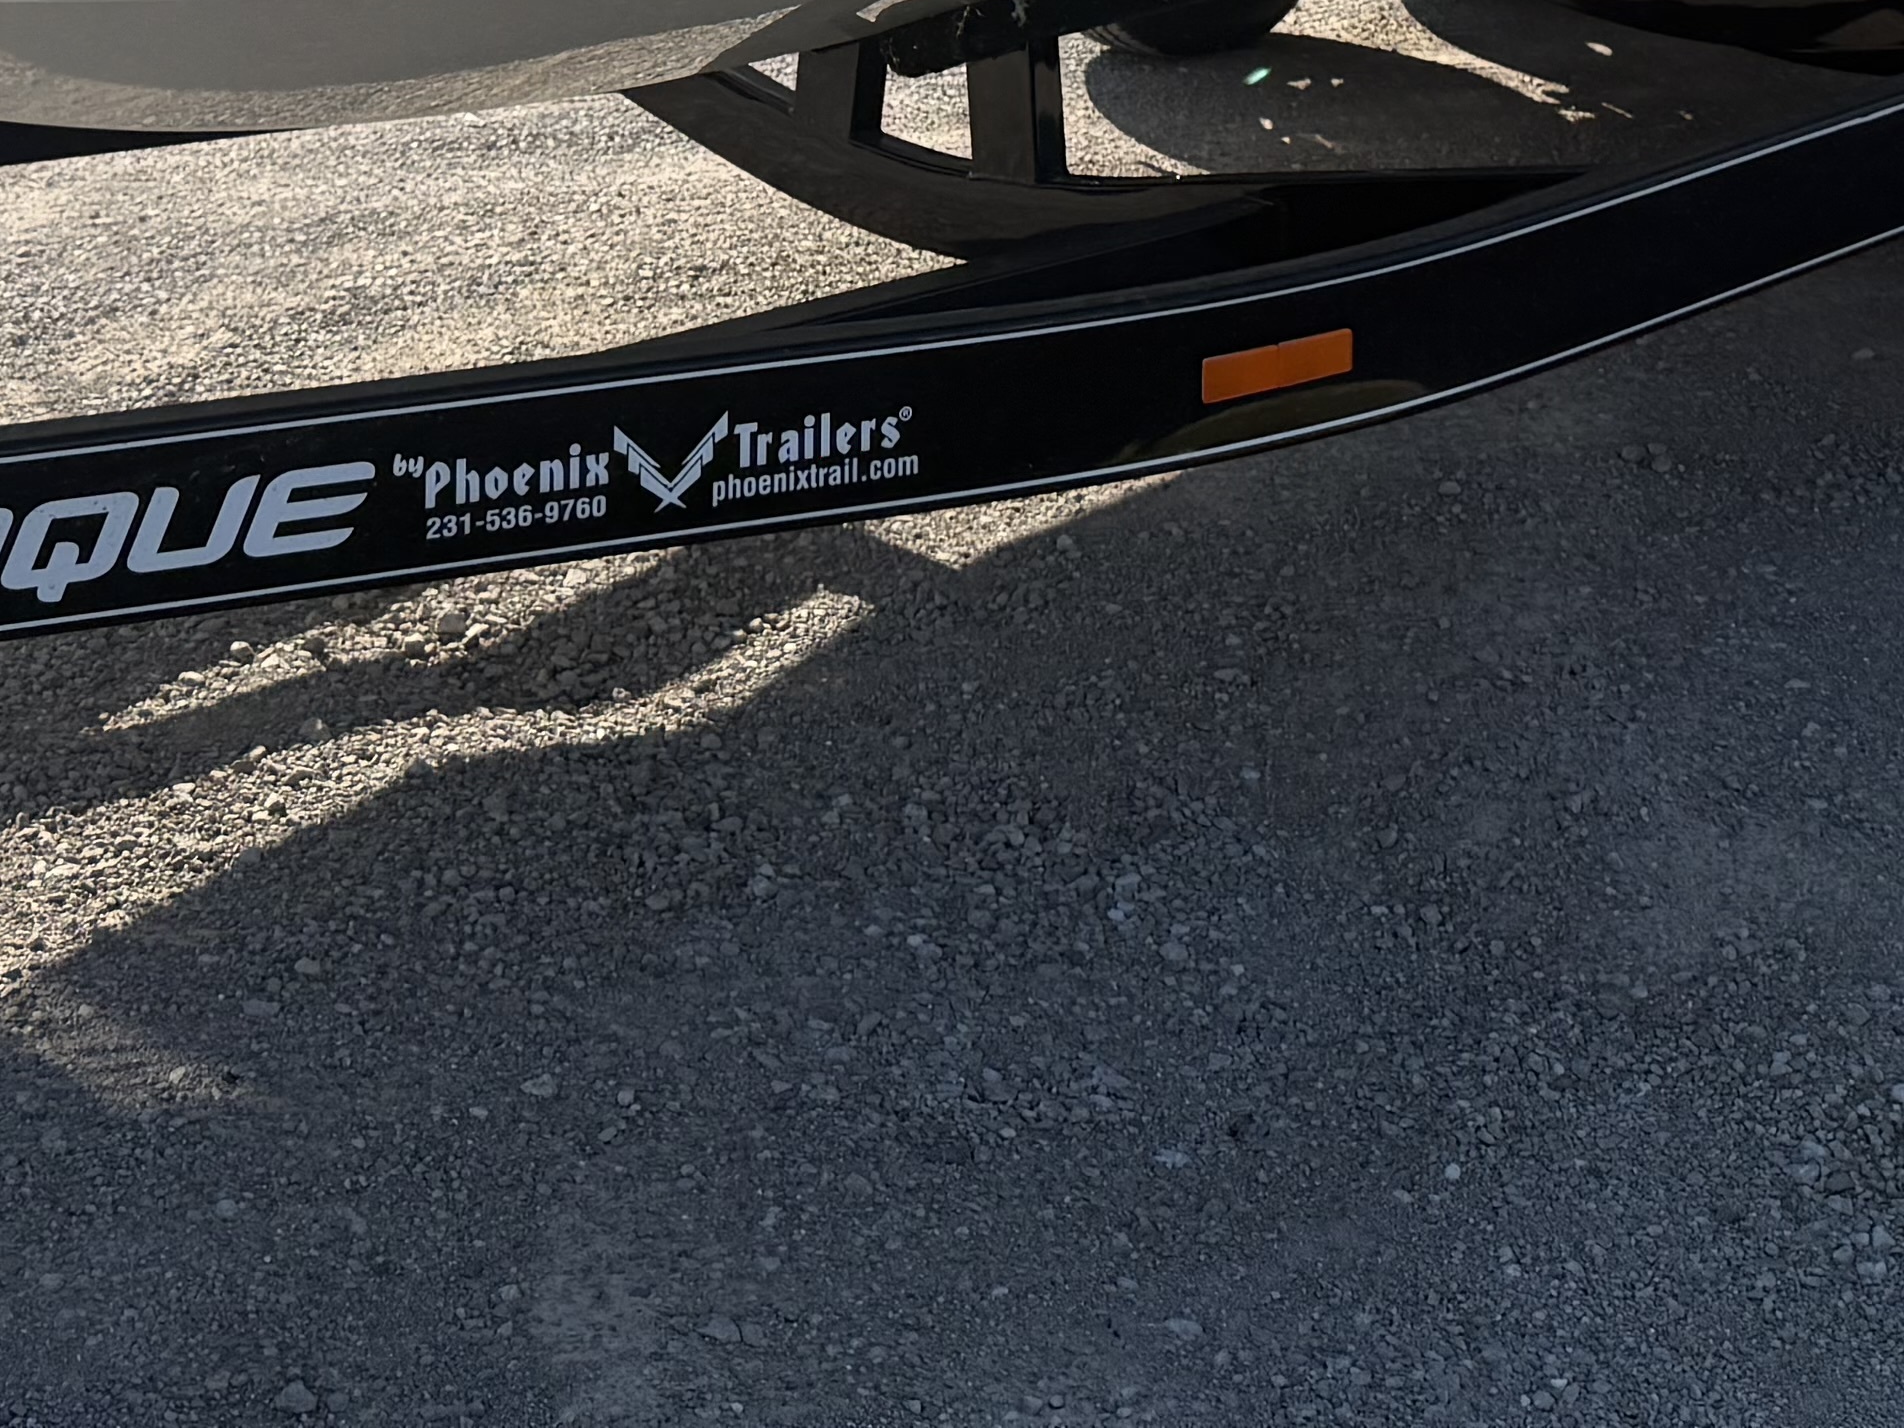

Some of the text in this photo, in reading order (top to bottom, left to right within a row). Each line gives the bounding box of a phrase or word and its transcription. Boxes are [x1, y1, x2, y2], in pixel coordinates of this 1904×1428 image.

[392, 453, 425, 478] by
[424, 443, 610, 509] Phoenix
[712, 454, 919, 508] phoenixtrail.com
[426, 495, 607, 540] 231-536-9760
